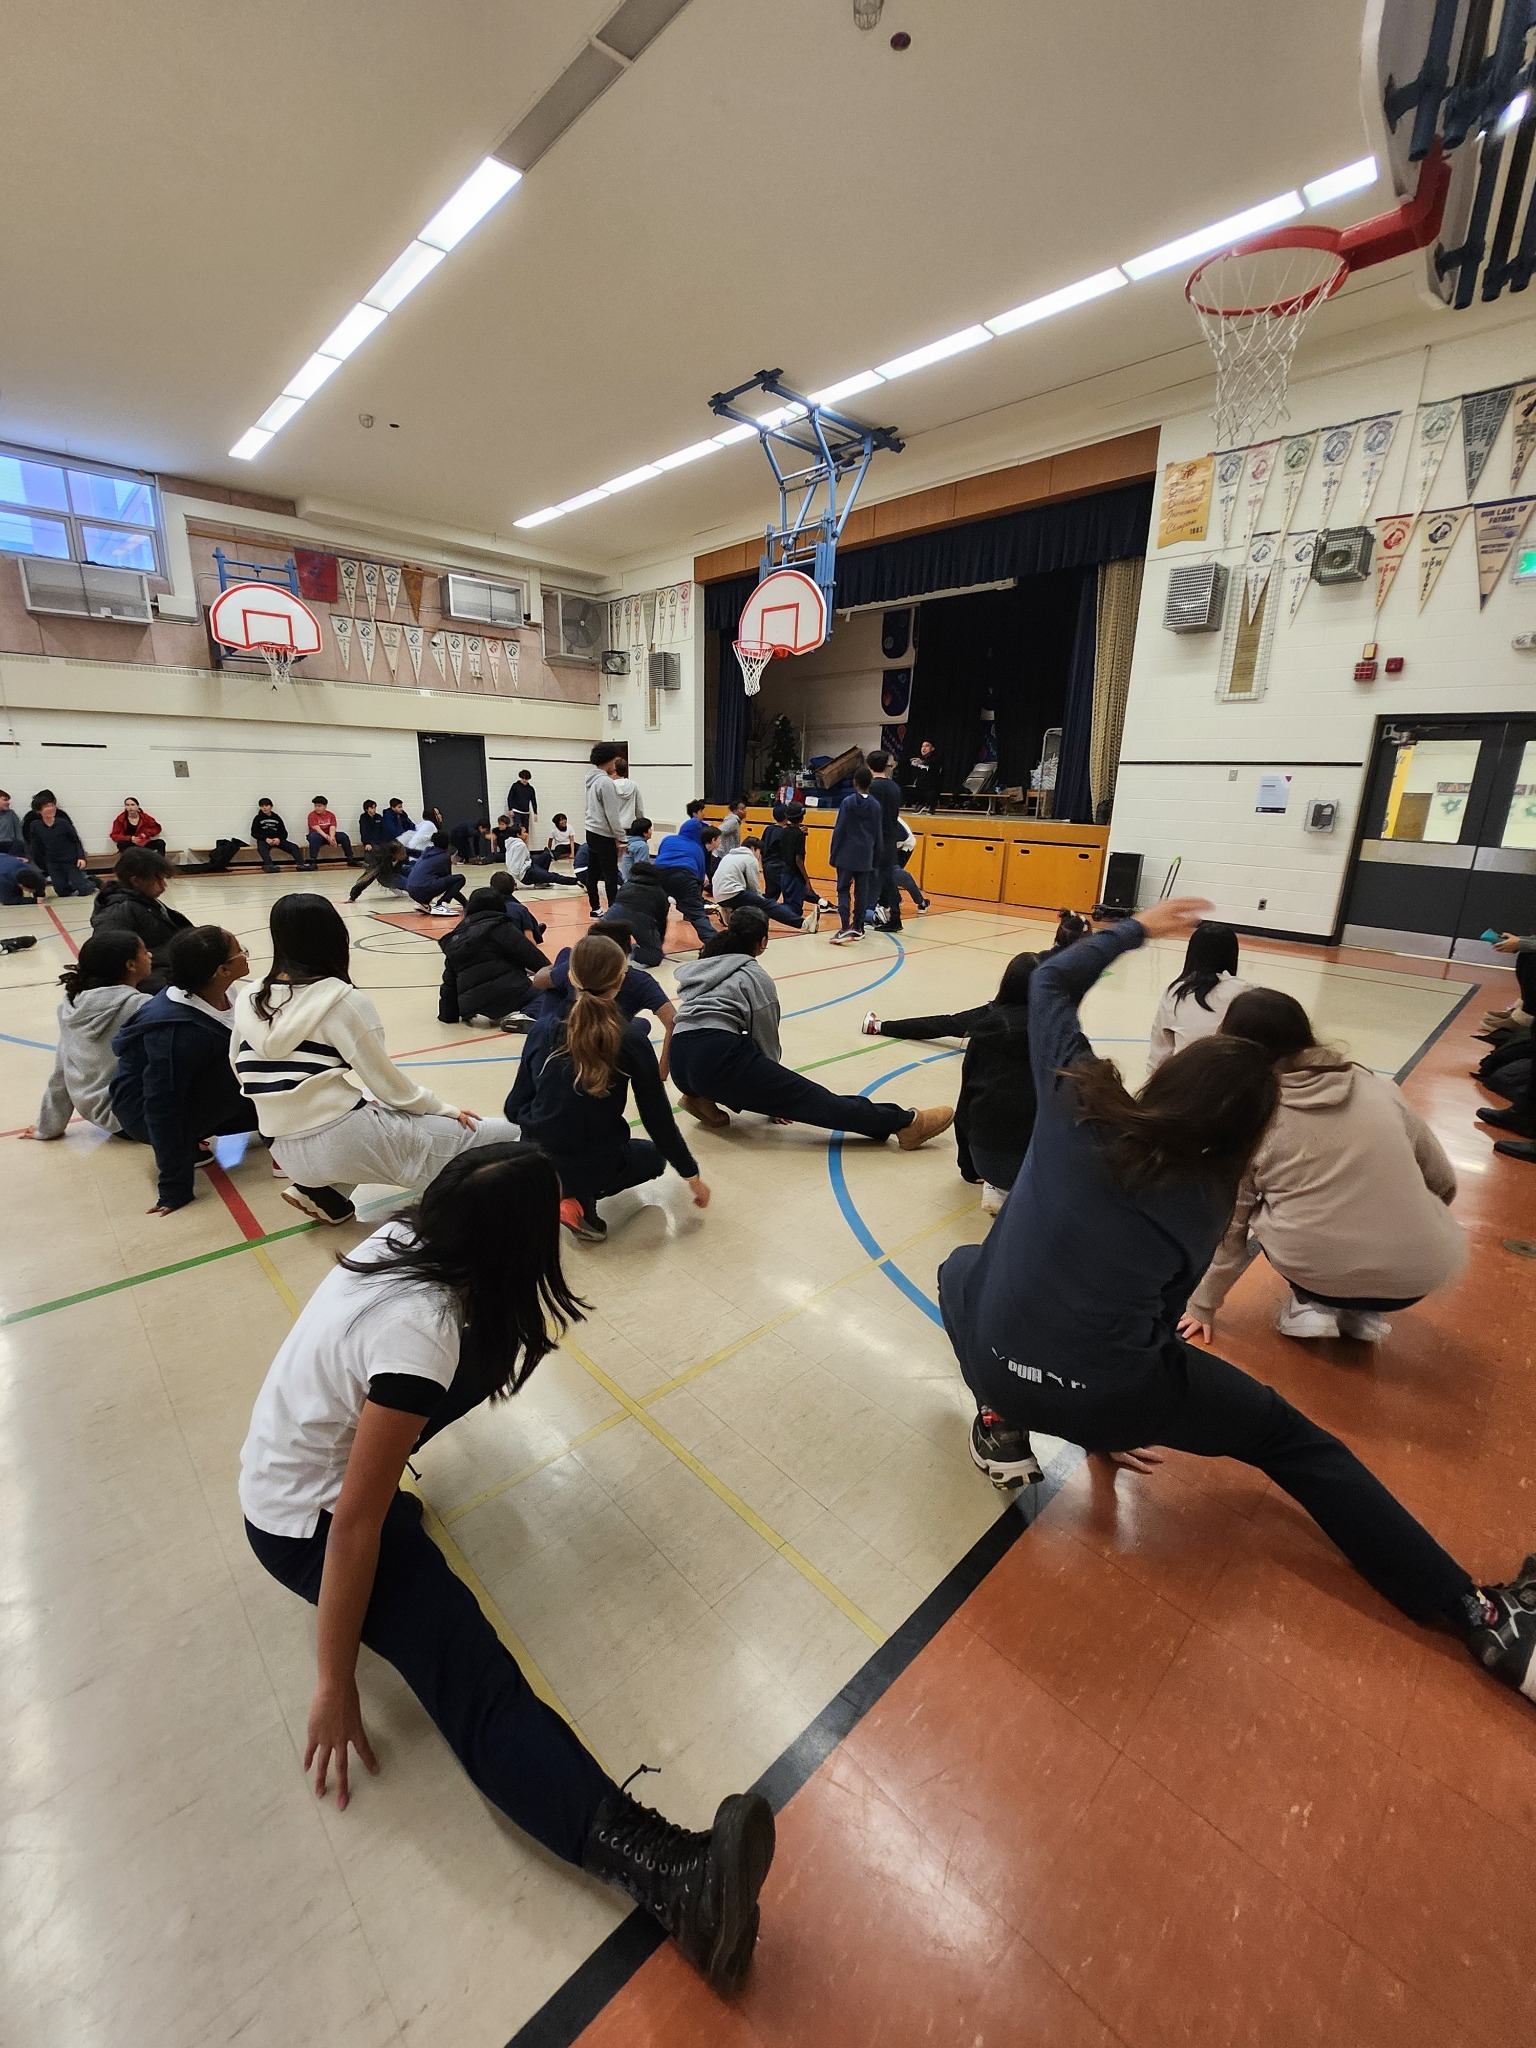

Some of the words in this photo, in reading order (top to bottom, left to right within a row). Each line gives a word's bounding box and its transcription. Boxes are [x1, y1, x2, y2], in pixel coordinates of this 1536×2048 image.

[1465, 399, 1474, 446] TOURNAMENT
[1473, 396, 1486, 441] BASKETBALL
[1488, 515, 1515, 524] FATIMA
[1497, 507, 1516, 515] LADY
[1008, 1360, 1042, 1384] PUMA
